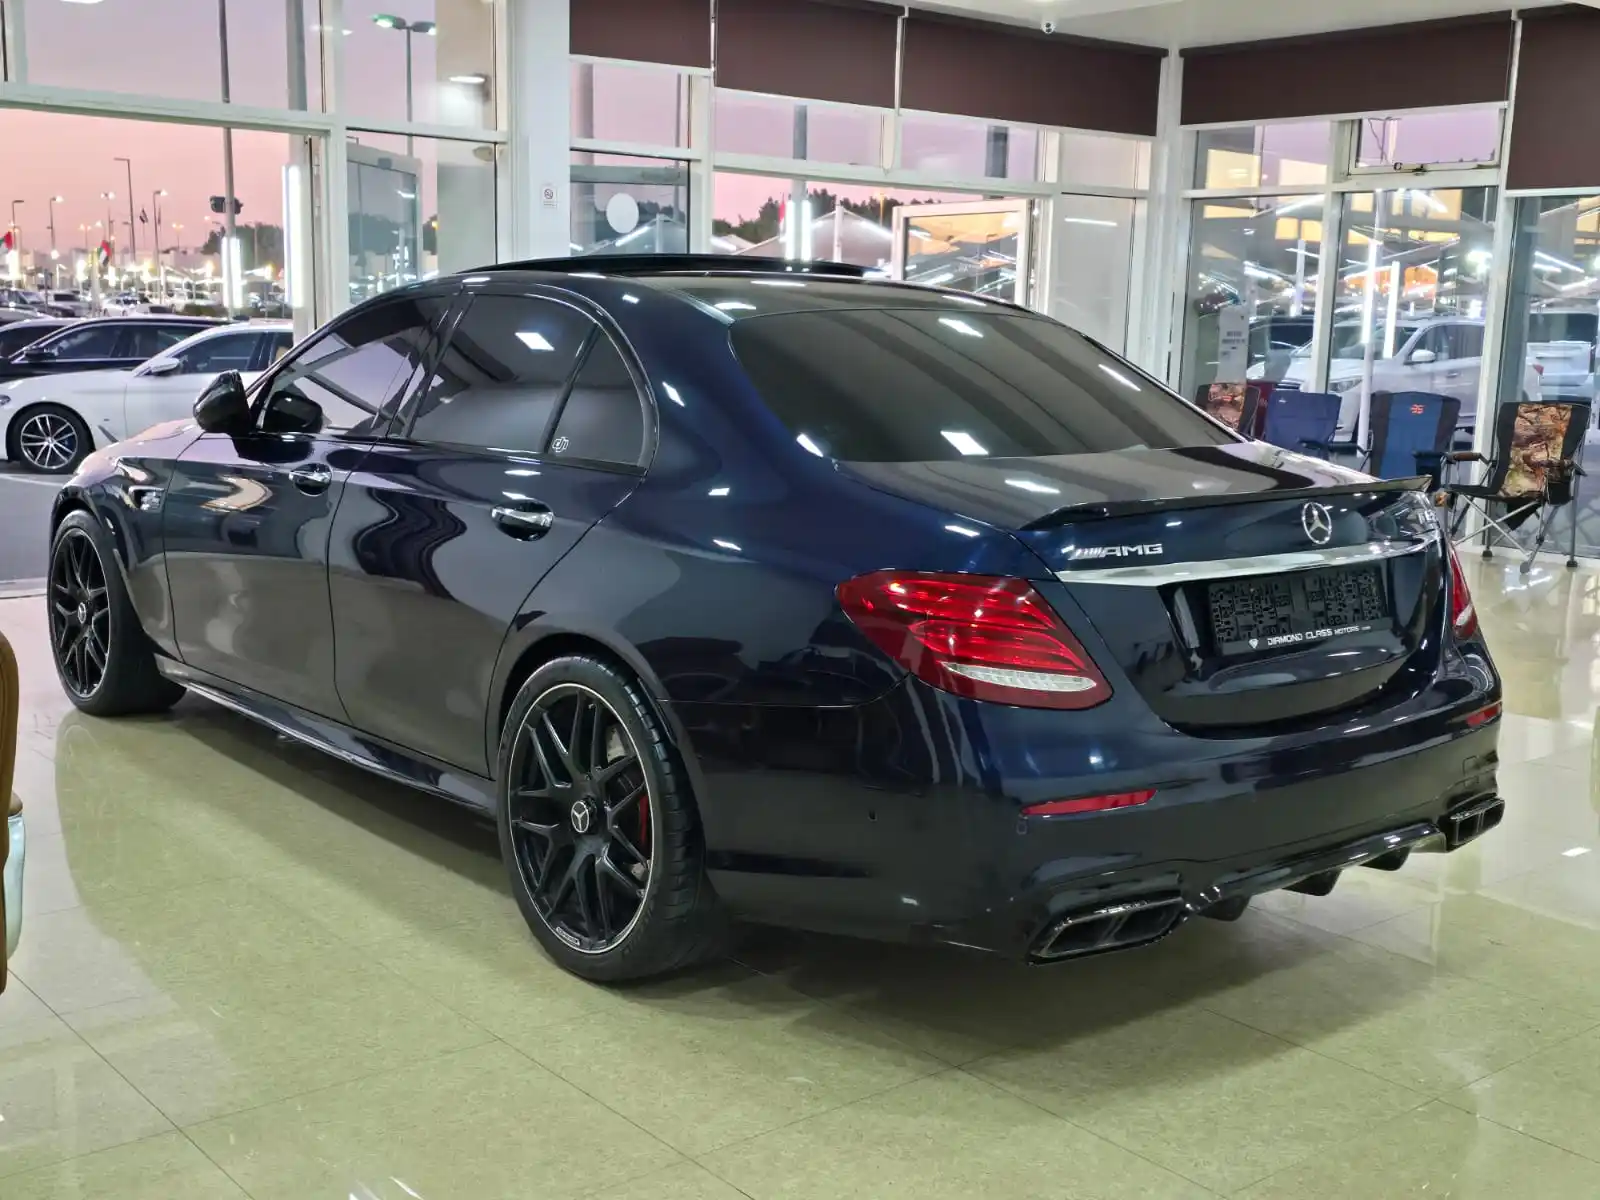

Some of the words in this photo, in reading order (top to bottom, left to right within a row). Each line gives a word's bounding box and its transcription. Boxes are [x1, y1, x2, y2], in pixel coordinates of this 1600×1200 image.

[1103, 543, 1163, 557] AMG
[1267, 633, 1303, 646] DIAMOND
[1305, 628, 1333, 640] CLASS
[1334, 625, 1360, 635] MOTORS
